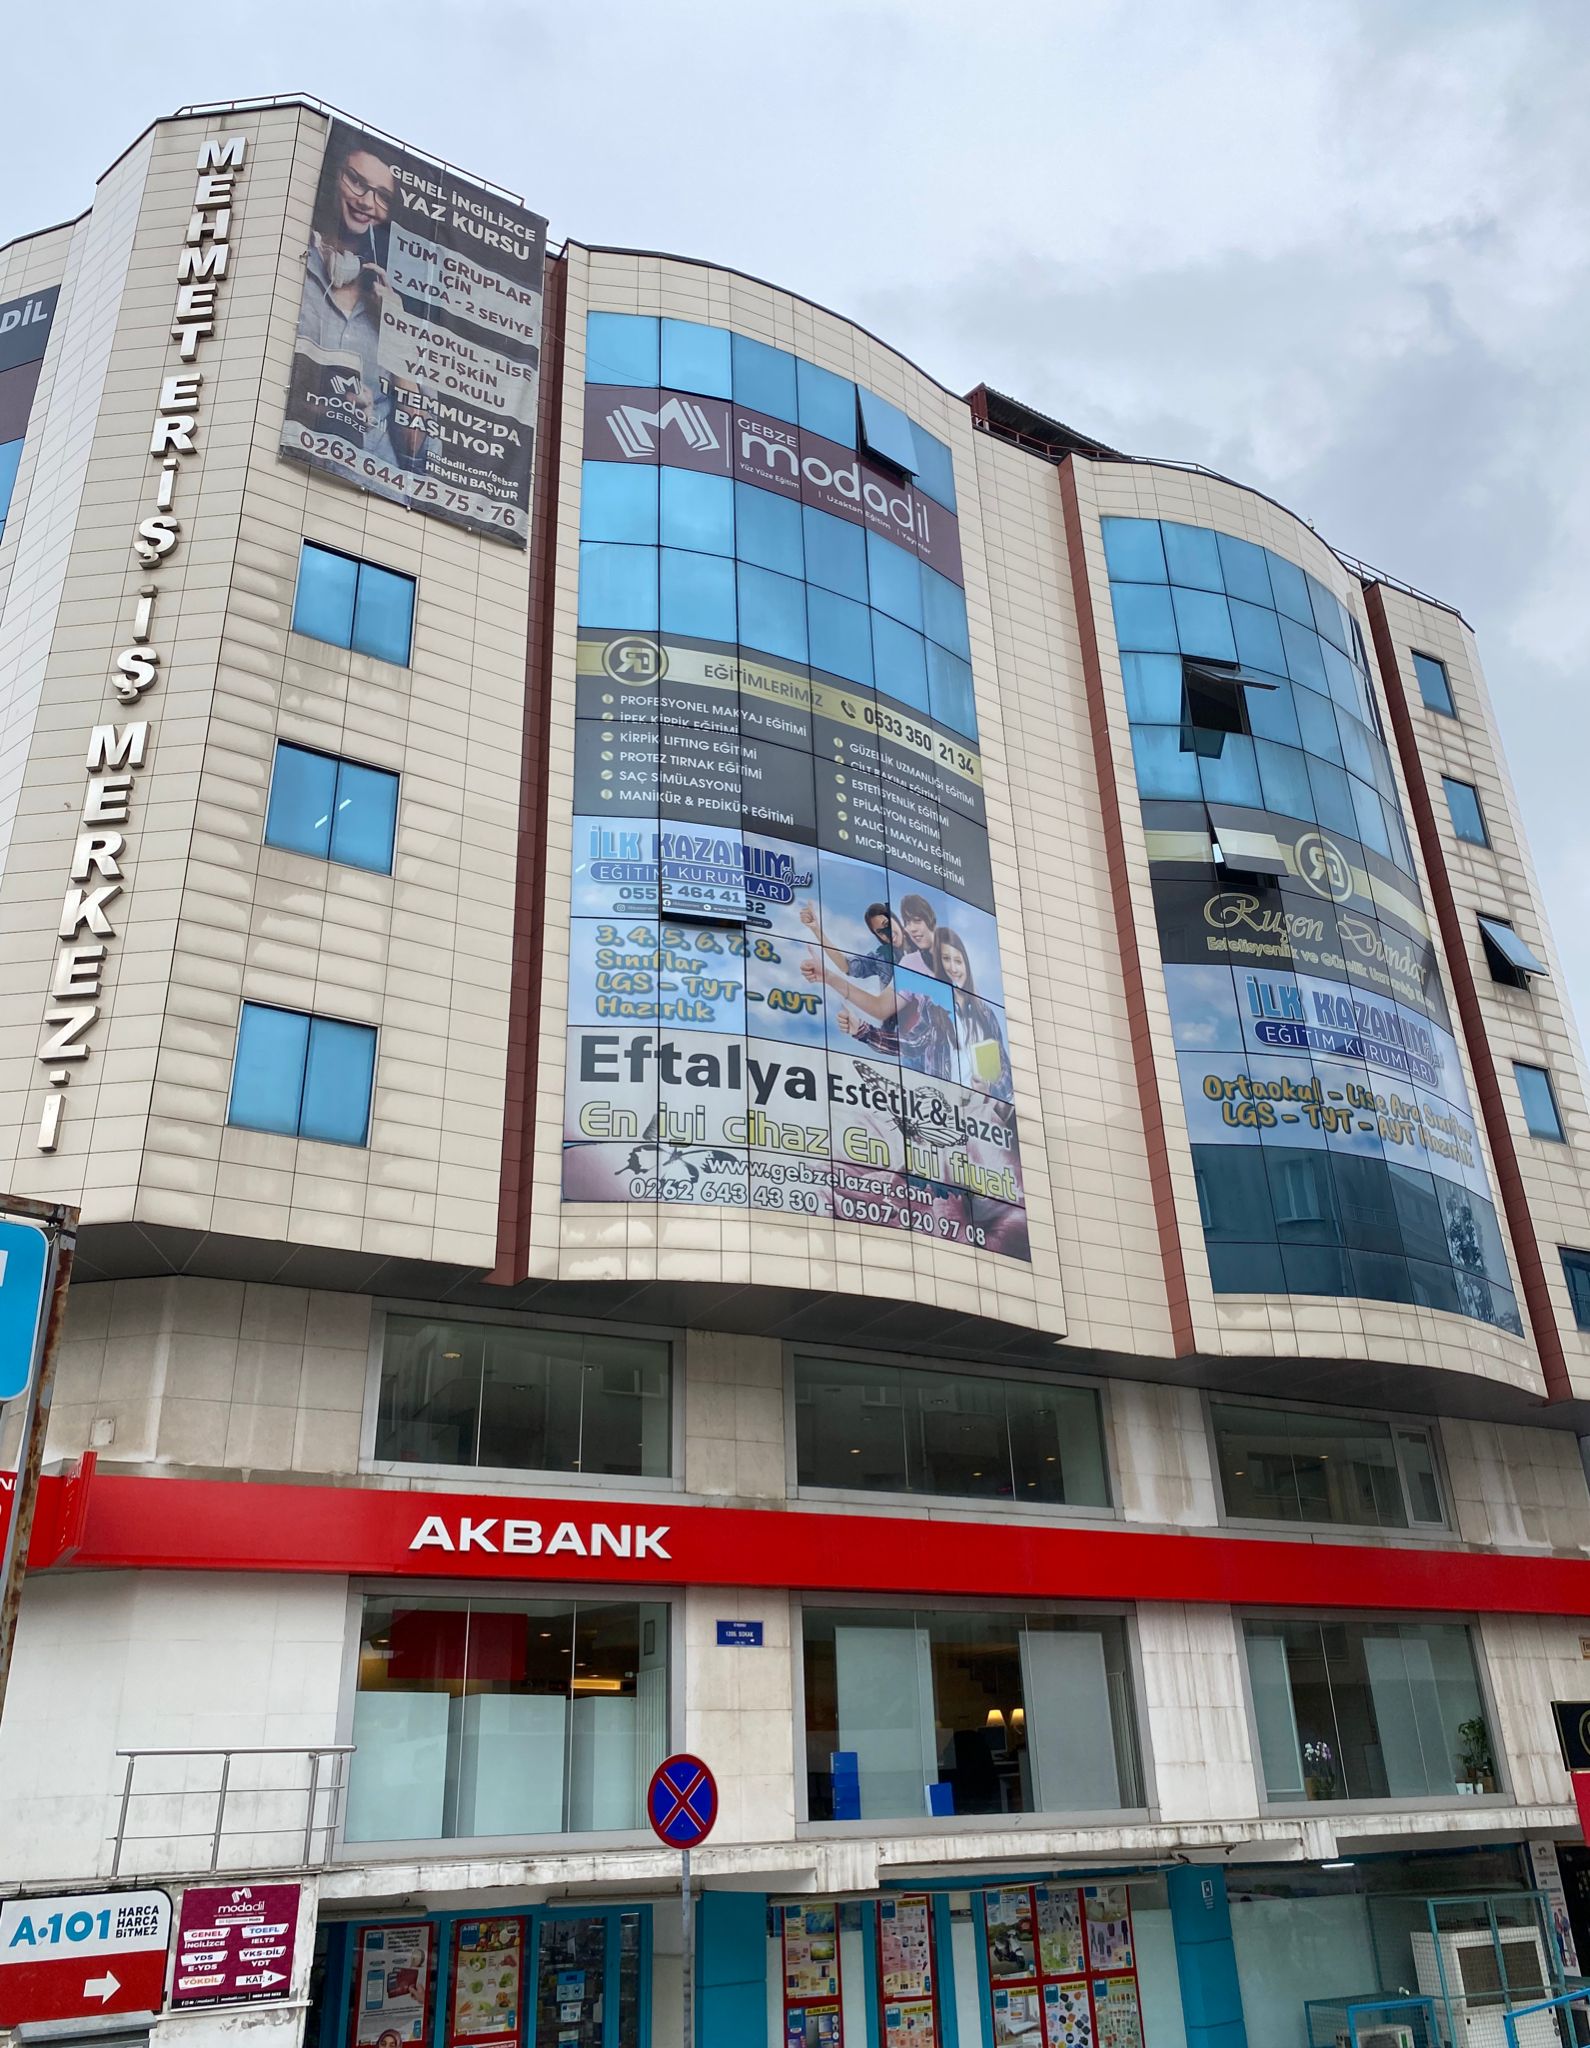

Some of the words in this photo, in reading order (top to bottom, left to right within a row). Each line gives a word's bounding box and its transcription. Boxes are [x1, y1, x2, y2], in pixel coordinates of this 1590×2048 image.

[389, 164, 447, 200] GENEL
[452, 190, 536, 242] İNGİLİZCE
[400, 187, 446, 222] YAZ
[452, 211, 529, 261] KURSU
[171, 136, 248, 362] MEHMET
[397, 236, 438, 265] TÜM
[444, 257, 532, 306] GRUPLAR
[439, 270, 472, 295] İÇİN
[394, 270, 402, 282] 2
[407, 277, 449, 301] AYDA
[466, 301, 474, 313] 2
[478, 308, 533, 338] SEVİYE
[383, 312, 478, 363] ORTAOKUL
[496, 358, 532, 383] LİSE
[416, 345, 497, 388] YETİŞKİN
[379, 377, 389, 394] 1
[405, 360, 439, 383] YAZ
[445, 375, 505, 408] OKULU
[306, 391, 387, 432] modadil
[326, 410, 367, 434] GEBZE
[737, 417, 797, 447] GEBZE
[395, 409, 505, 459] BAŞLIYOR
[134, 373, 203, 569] ERİŞ
[300, 431, 357, 468] 0262
[363, 458, 405, 490] 644
[413, 478, 438, 500] 75
[444, 489, 469, 513] 75
[491, 505, 516, 526] 76
[425, 461, 467, 486] HEMEN
[469, 477, 519, 500] BAŞVUR
[427, 450, 519, 488] modadil.com/gebze
[740, 462, 754, 472] Yüz
[755, 468, 773, 480] Yüze
[775, 475, 800, 489] Eğitim
[741, 432, 930, 543] modadil
[111, 584, 160, 705] İŞ
[704, 664, 823, 707] EĞİTİMLERİMİZ
[620, 695, 709, 713] PROFESYONEL
[713, 706, 762, 724] MAKYAJ
[766, 717, 807, 736] EĞİTİMİ
[620, 731, 659, 744] KİRPİK
[664, 736, 709, 750] LIFTING
[620, 752, 666, 763] PROTEZ
[670, 755, 715, 770] TIRNAK
[864, 707, 903, 737] 0533
[906, 725, 932, 751] 350
[939, 743, 954, 764] 21
[958, 754, 974, 775] 34
[620, 771, 647, 784] SAÇ
[651, 771, 741, 793] SİMÜLASYONU
[850, 744, 894, 766] GÜZELLİK
[945, 784, 974, 807] EĞİTİMİ
[620, 789, 681, 804] MANİKÜR
[685, 796, 693, 806] &
[698, 798, 748, 814] PEDİKÜR
[752, 807, 794, 825] EĞİTİMİ
[589, 826, 640, 860] İLK
[651, 832, 793, 880] KAZANIM
[854, 816, 888, 835] KALICI
[890, 828, 928, 852] MAKYAJ
[855, 835, 931, 870] MICROBLADING
[600, 864, 669, 880] EĞİTİM
[678, 868, 785, 900] KURUMLARI
[678, 886, 715, 900] 464
[720, 891, 740, 903] 41
[37, 721, 151, 1153] MERKEZİ
[596, 925, 624, 946] 3.
[627, 926, 657, 947] 4.
[662, 928, 691, 950] 5.
[695, 932, 724, 954] 6.
[754, 939, 781, 963] 8.
[1301, 951, 1318, 964] ve
[595, 949, 708, 974] Sınıflar
[596, 972, 652, 993] LGS
[681, 976, 742, 1001] TYT
[767, 988, 822, 1015] AYT
[596, 995, 716, 1022] Hazırlık
[1246, 974, 1306, 1020] İLK
[1312, 991, 1431, 1059] KAZANIM
[1265, 1025, 1335, 1049] EĞİTİM
[1344, 1039, 1434, 1084] KURUMLARI
[580, 1035, 816, 1101] Eftalya
[828, 1073, 926, 1121] Estetik
[930, 1098, 947, 1128] &
[955, 1105, 1012, 1149] Lazer
[1202, 1074, 1325, 1105] Ortaokul
[1222, 1102, 1277, 1127] LGS
[580, 1101, 638, 1137] En
[659, 1102, 706, 1148] iyi
[722, 1109, 830, 1155] cihaz
[843, 1126, 890, 1167] En
[906, 1139, 940, 1179] iyi
[949, 1151, 1017, 1201] fiyat
[707, 1158, 933, 1206] www.gebzelazer.com
[630, 1178, 694, 1200] 0262
[701, 1182, 747, 1204] 643
[754, 1186, 783, 1208] 43
[789, 1190, 819, 1212] 30
[842, 1199, 893, 1223] 0507
[900, 1209, 934, 1232] 020
[938, 1219, 960, 1238] 97
[965, 1225, 986, 1246] 08
[408, 1515, 672, 1559] AKBANK
[117, 1916, 158, 1928] HARCA
[118, 1905, 159, 1918] HARCA
[218, 1901, 265, 1913] modadil
[188, 1964, 217, 1972] E-YDS
